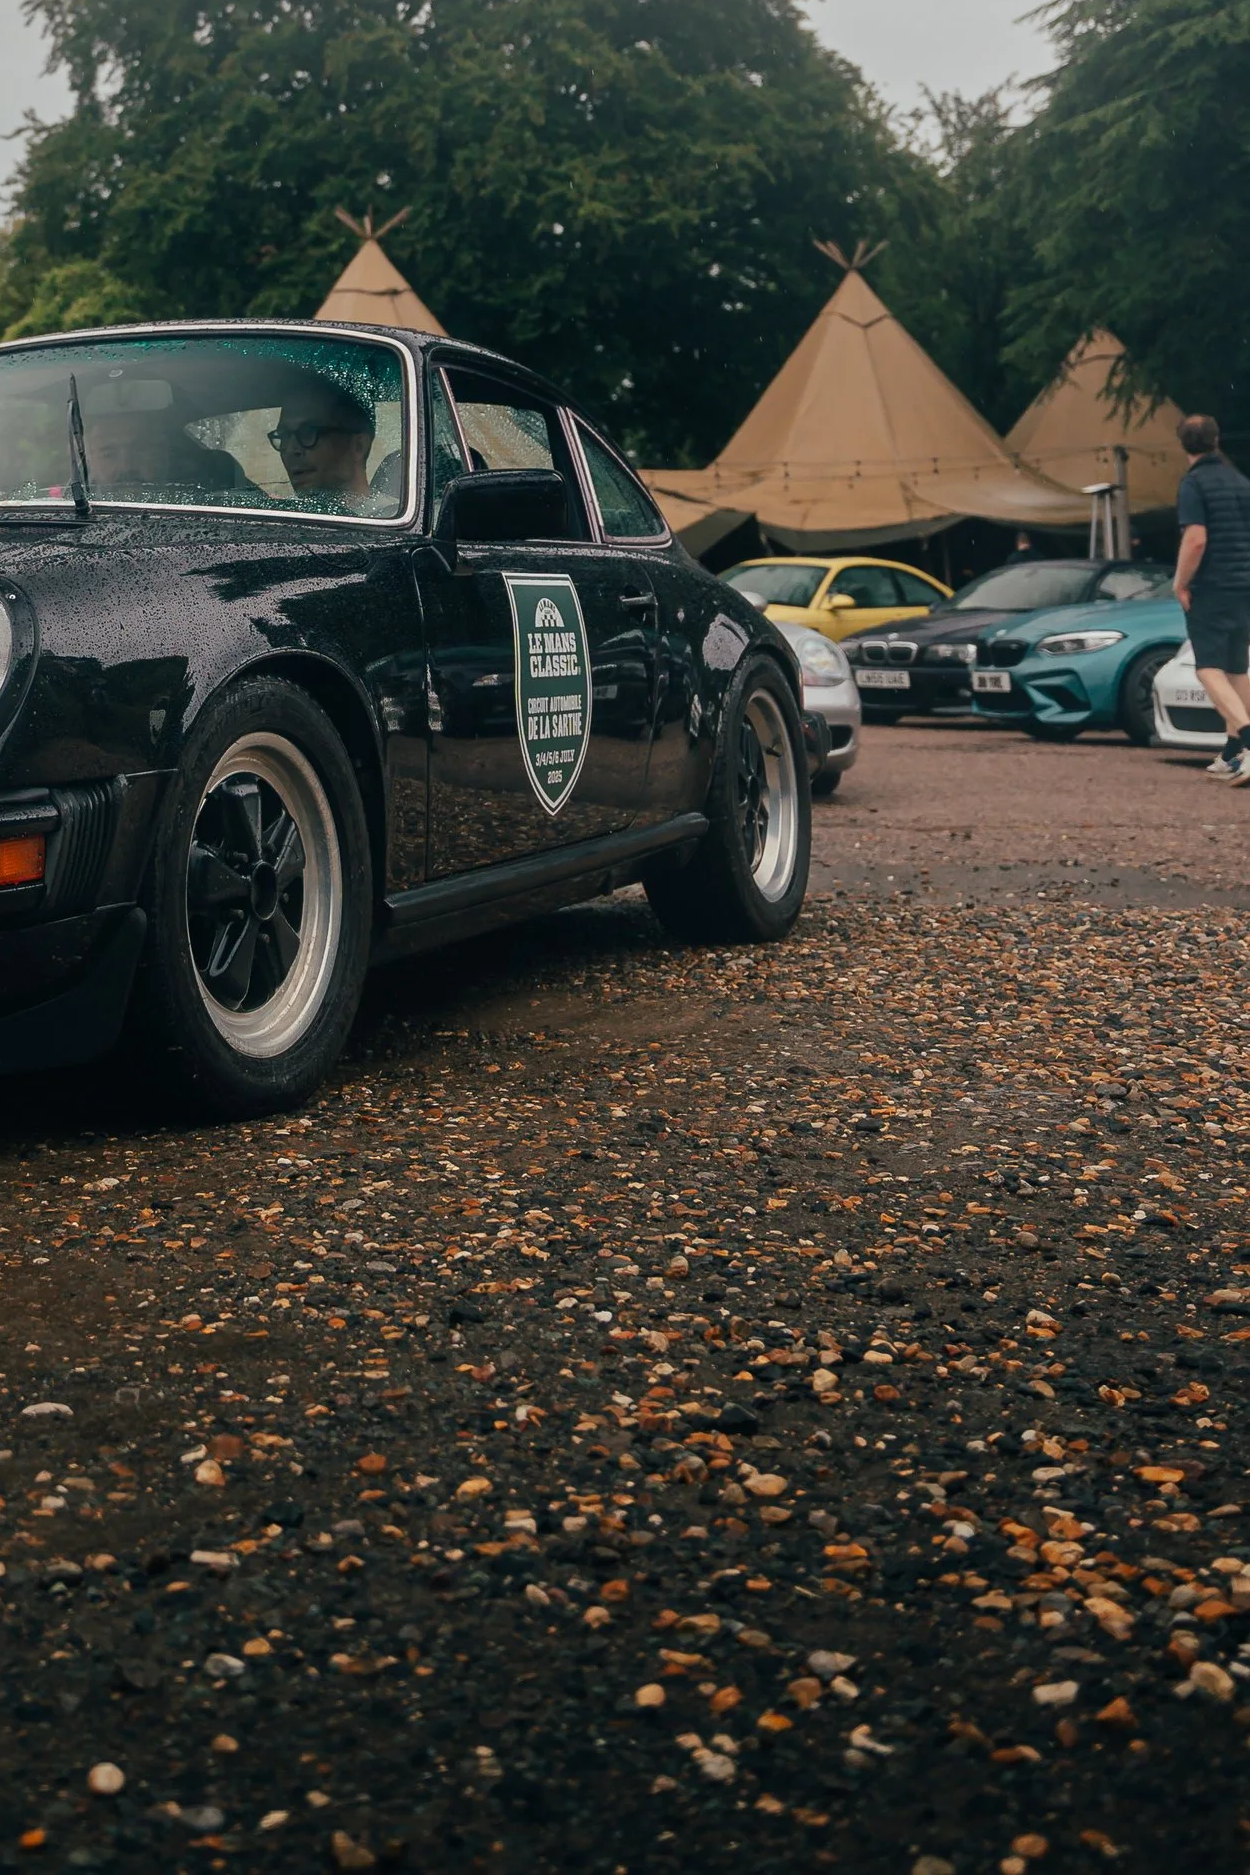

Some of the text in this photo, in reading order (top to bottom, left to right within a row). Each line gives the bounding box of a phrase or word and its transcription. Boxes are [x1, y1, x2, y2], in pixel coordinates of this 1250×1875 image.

[527, 632, 577, 654] LE MANS
[530, 654, 578, 677] CLASSIC
[528, 694, 582, 714] CIRCUIT AUTOMOBILE
[528, 712, 582, 741] DE LA SARTHE
[535, 748, 576, 767] 3/4/5/6 JULY
[547, 769, 563, 784] 2025
